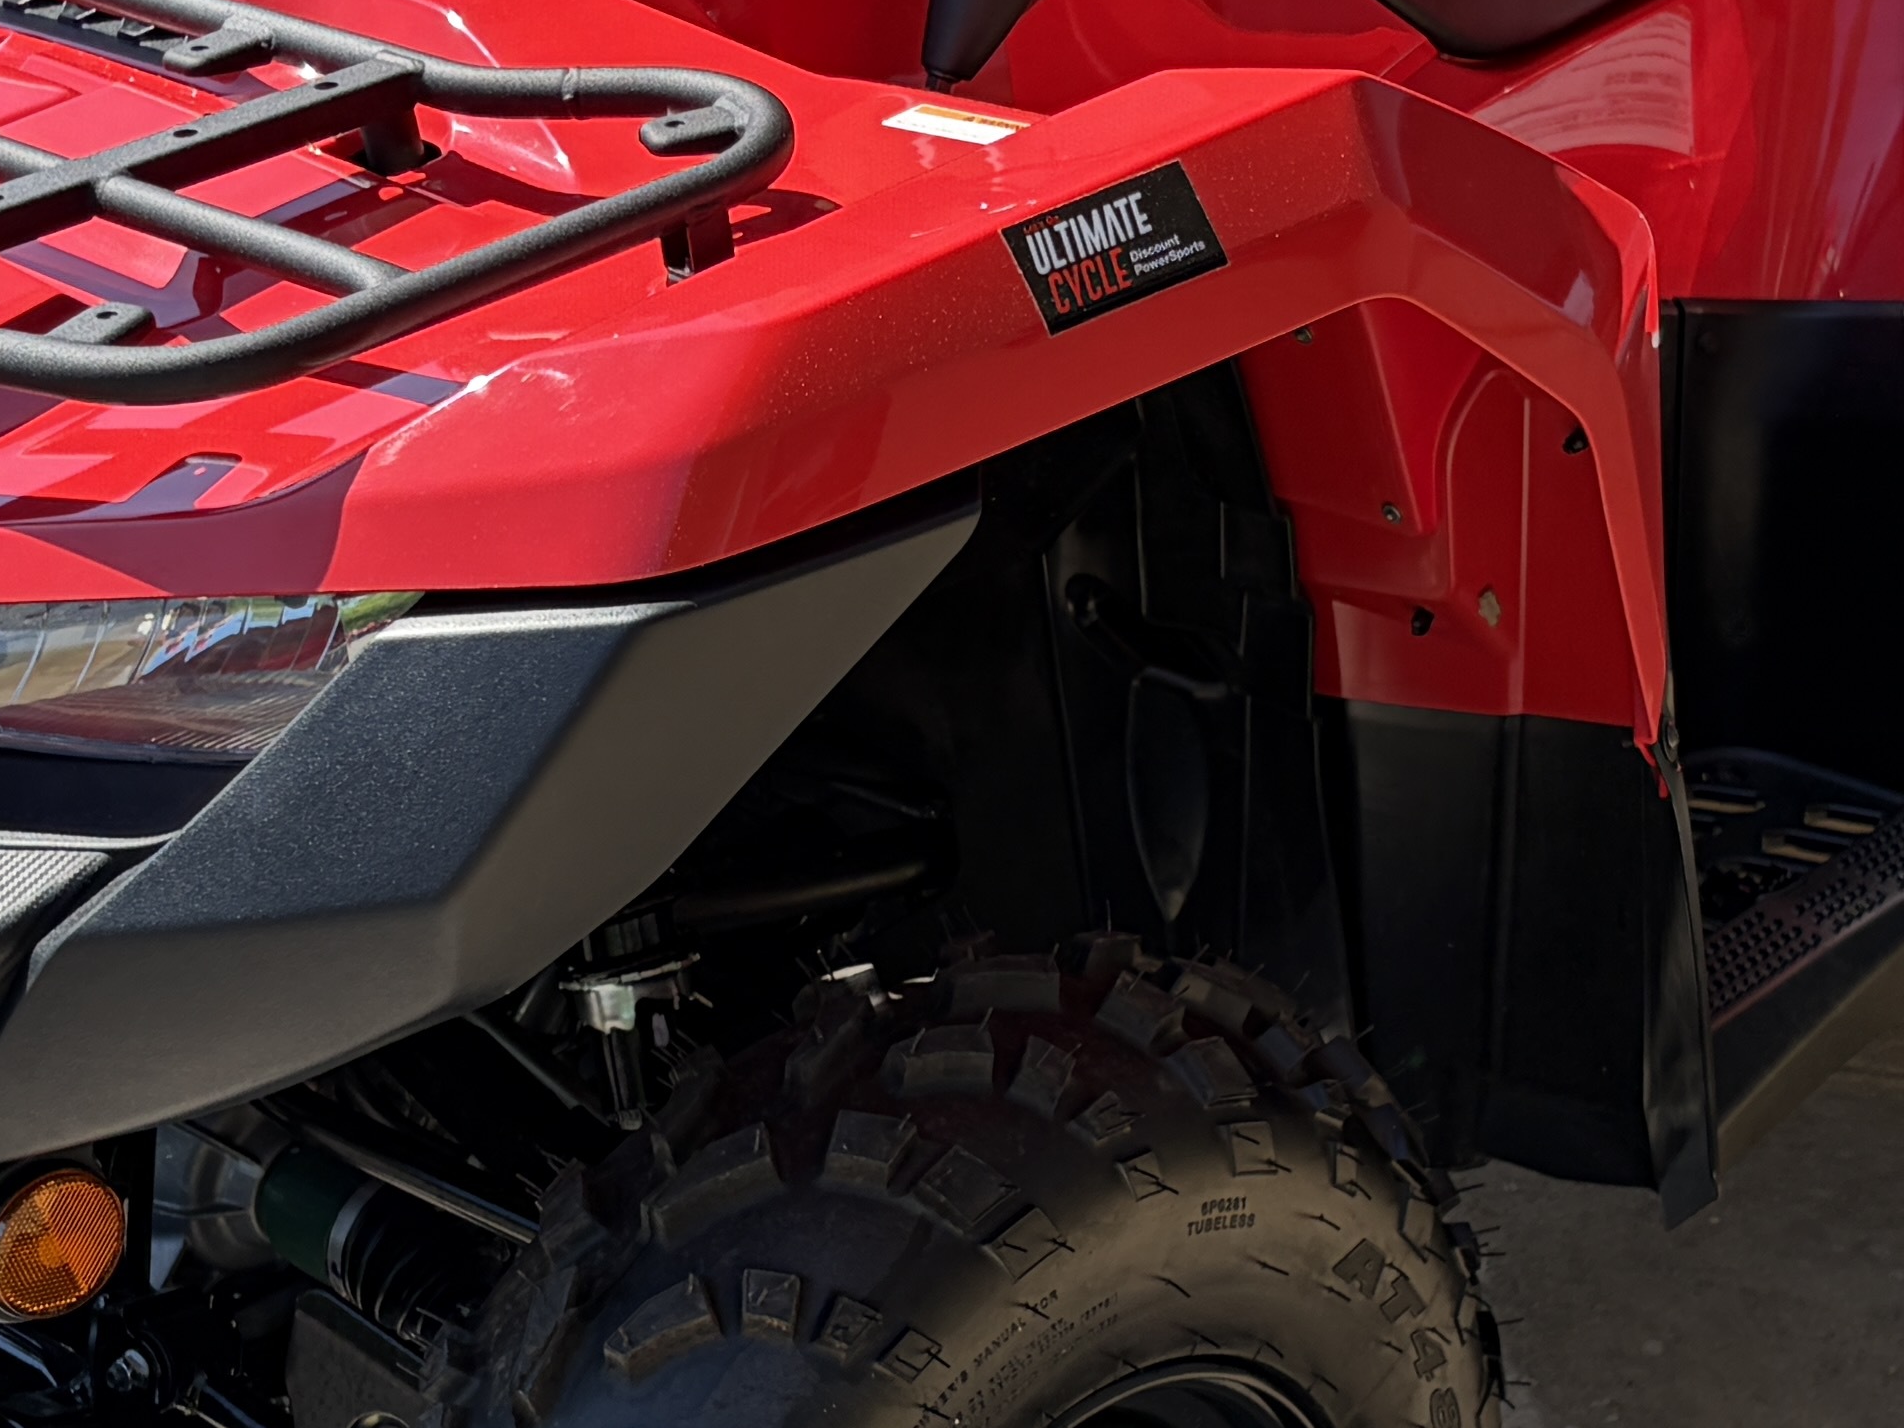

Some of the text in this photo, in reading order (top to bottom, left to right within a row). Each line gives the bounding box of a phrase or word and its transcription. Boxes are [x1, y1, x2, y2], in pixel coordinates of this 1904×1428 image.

[1026, 192, 1153, 275] ULTIMATE
[1129, 233, 1181, 262] Discount
[1048, 247, 1134, 315] CYCLE
[1134, 240, 1206, 277] PowerSports
[1187, 1211, 1256, 1236] TUBELESS
[971, 1315, 1027, 1369] MANUAL
